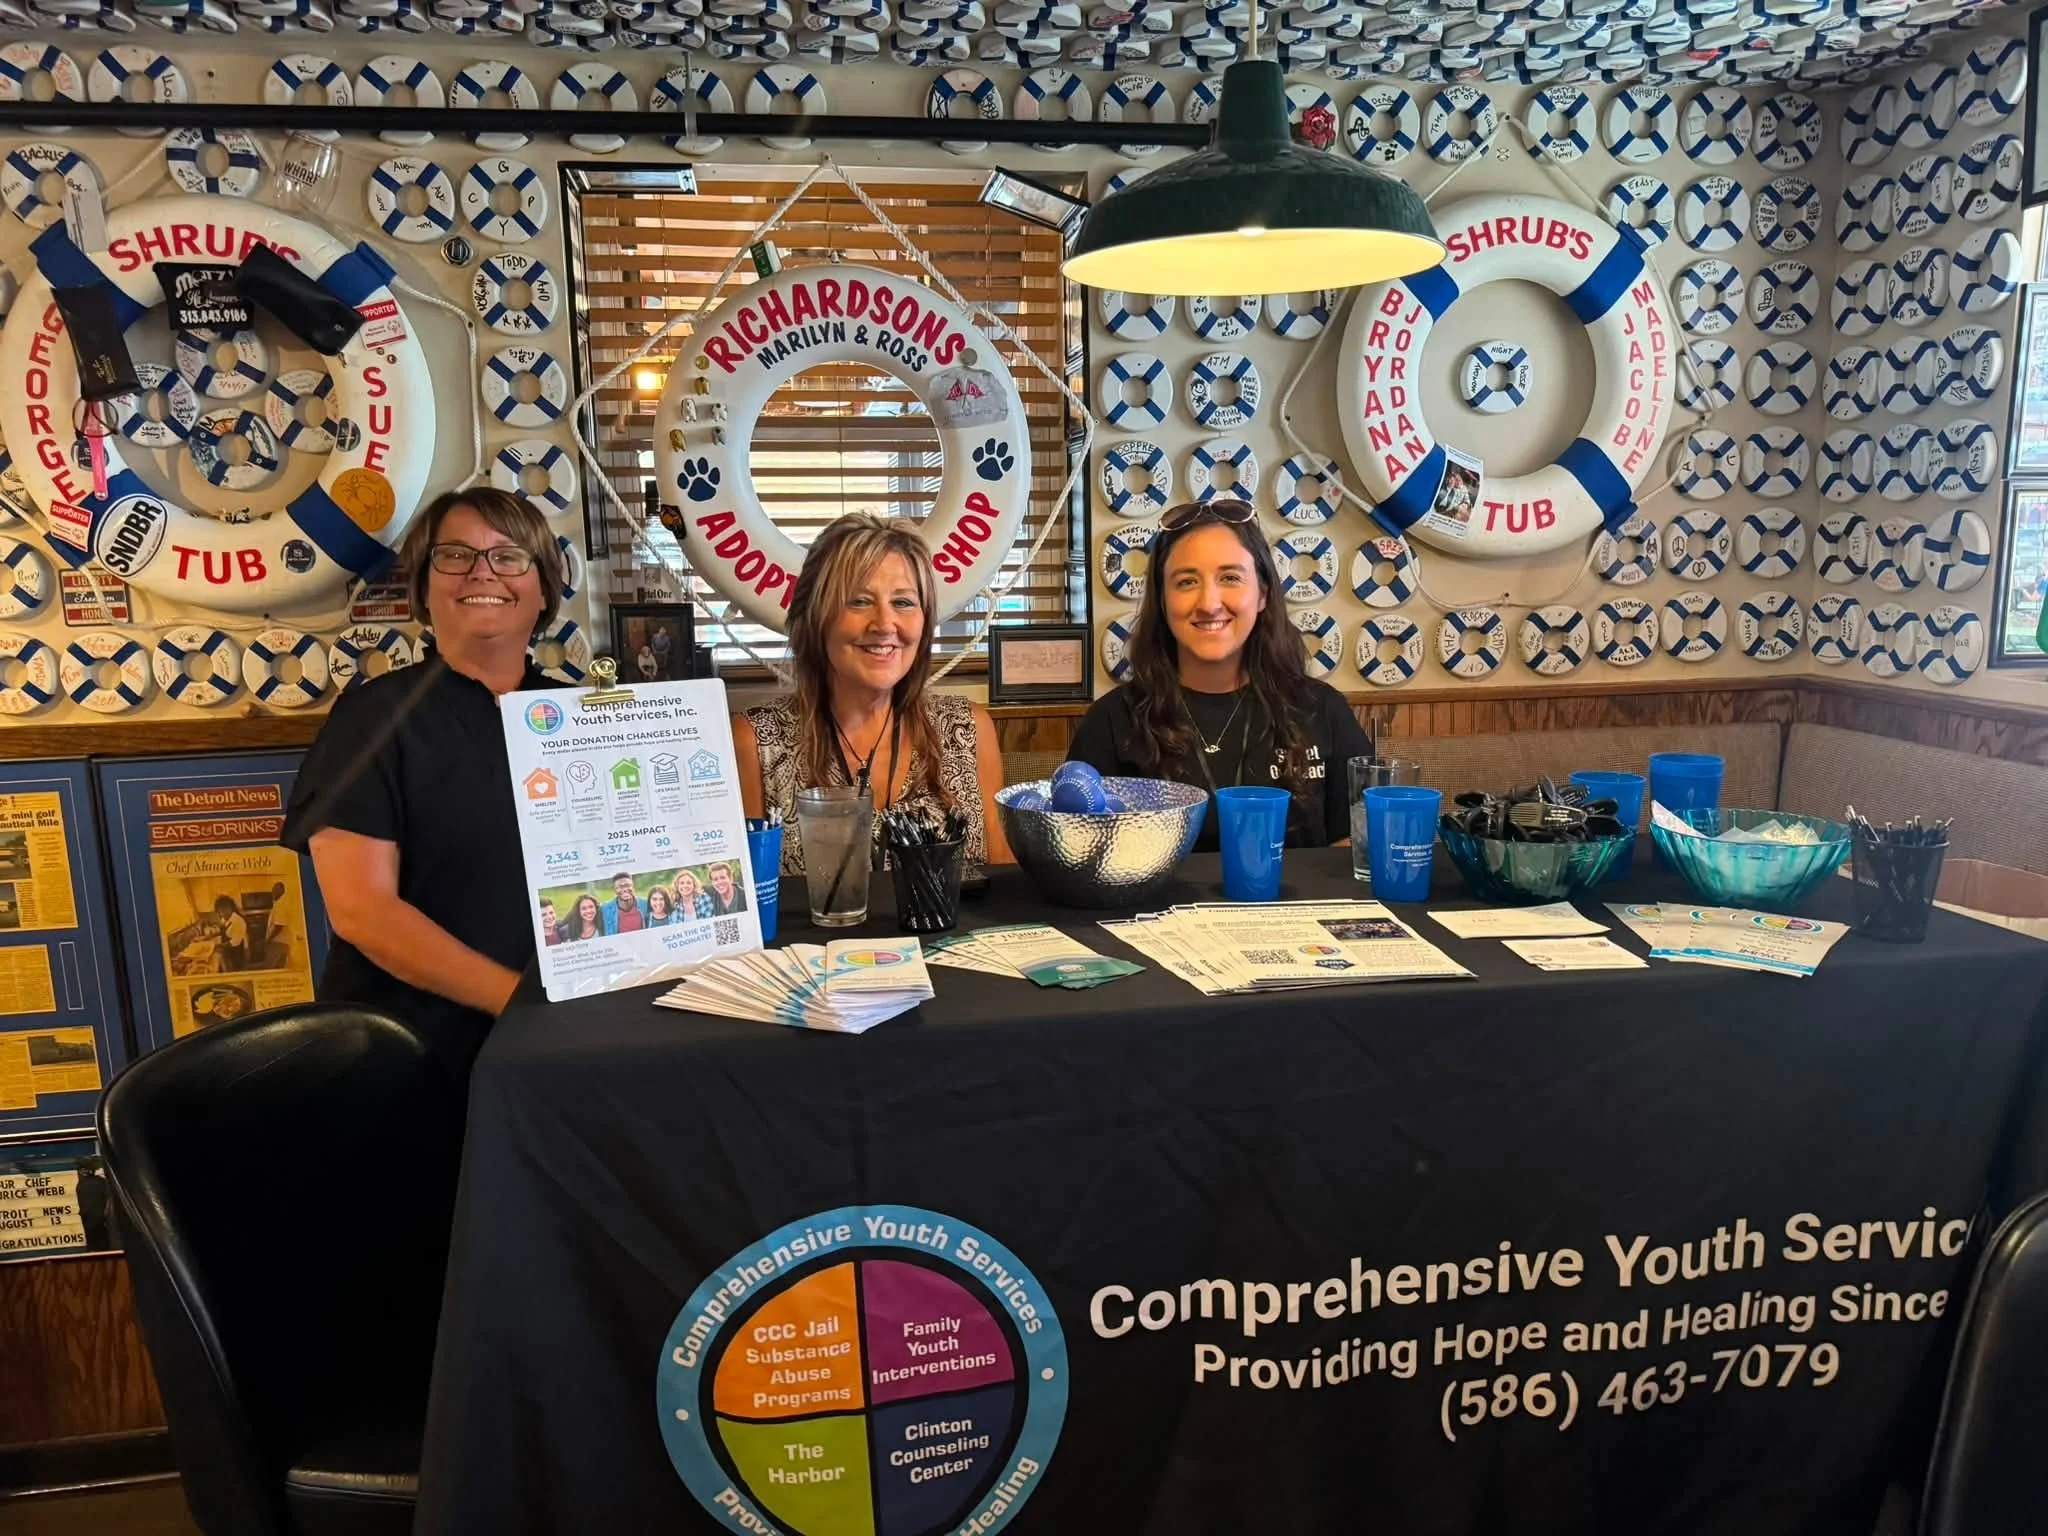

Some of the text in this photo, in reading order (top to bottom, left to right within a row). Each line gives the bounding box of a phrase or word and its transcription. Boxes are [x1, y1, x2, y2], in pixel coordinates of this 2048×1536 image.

[1446, 215, 1595, 263] SHRUB'S
[703, 278, 966, 374] RICHARDSONS
[755, 321, 929, 373] MARILYN & ROSS
[1363, 287, 1408, 483] BRYANA
[1389, 305, 1427, 458] JORDAN
[1611, 312, 1646, 448] JACOB
[1620, 280, 1669, 475] MADELINE
[26, 301, 87, 505] GEORGE
[362, 366, 392, 474] SUE
[1482, 497, 1557, 534] TUB
[105, 500, 164, 574] SNDBR
[932, 491, 1001, 584] SHOP
[171, 544, 268, 586] TUB
[696, 511, 795, 610] ADOPT
[71, 575, 115, 586] LIBTY
[1460, 610, 1491, 626] ROCKS
[572, 706, 697, 727] Youth Services, Inc.
[581, 695, 682, 714] Comprehensive
[541, 727, 698, 749] YOUR DONATION CHANGES LIVES
[151, 788, 278, 806] The Detroit News
[0, 820, 35, 829] autical
[152, 824, 199, 840] EATS
[213, 819, 279, 837] DRINKS
[607, 825, 667, 840] 2025 IMPACT
[655, 836, 671, 848] 90
[166, 860, 192, 875] Chef
[242, 857, 272, 871] Webb
[0, 1177, 52, 1190] UR CHEF
[36, 1186, 65, 1197] WEBB
[0, 1217, 62, 1230] UGUST 13
[43, 1206, 72, 1217] NEWS
[0, 1233, 84, 1249] GRATULATIONS
[1089, 1206, 1972, 1340] Comprehensive Youth Servic
[671, 1216, 1043, 1369] Comprehensive Youth Services
[753, 1316, 840, 1343] CCC Jail
[903, 1318, 961, 1338] Family
[1193, 1283, 1949, 1391] Providing Hope and Healing Since
[746, 1340, 851, 1365] Substance
[906, 1337, 960, 1357] Youth
[770, 1366, 831, 1386] Abuse
[872, 1352, 997, 1384] Interventions
[753, 1387, 851, 1409] Programs
[1440, 1342, 1840, 1442] (586) 463-7079
[904, 1418, 973, 1441] Clinton
[784, 1443, 825, 1461] The
[890, 1433, 990, 1467] Counseling
[768, 1465, 846, 1486] Harbor
[910, 1456, 974, 1484] Center
[960, 1456, 1040, 1536] Healing
